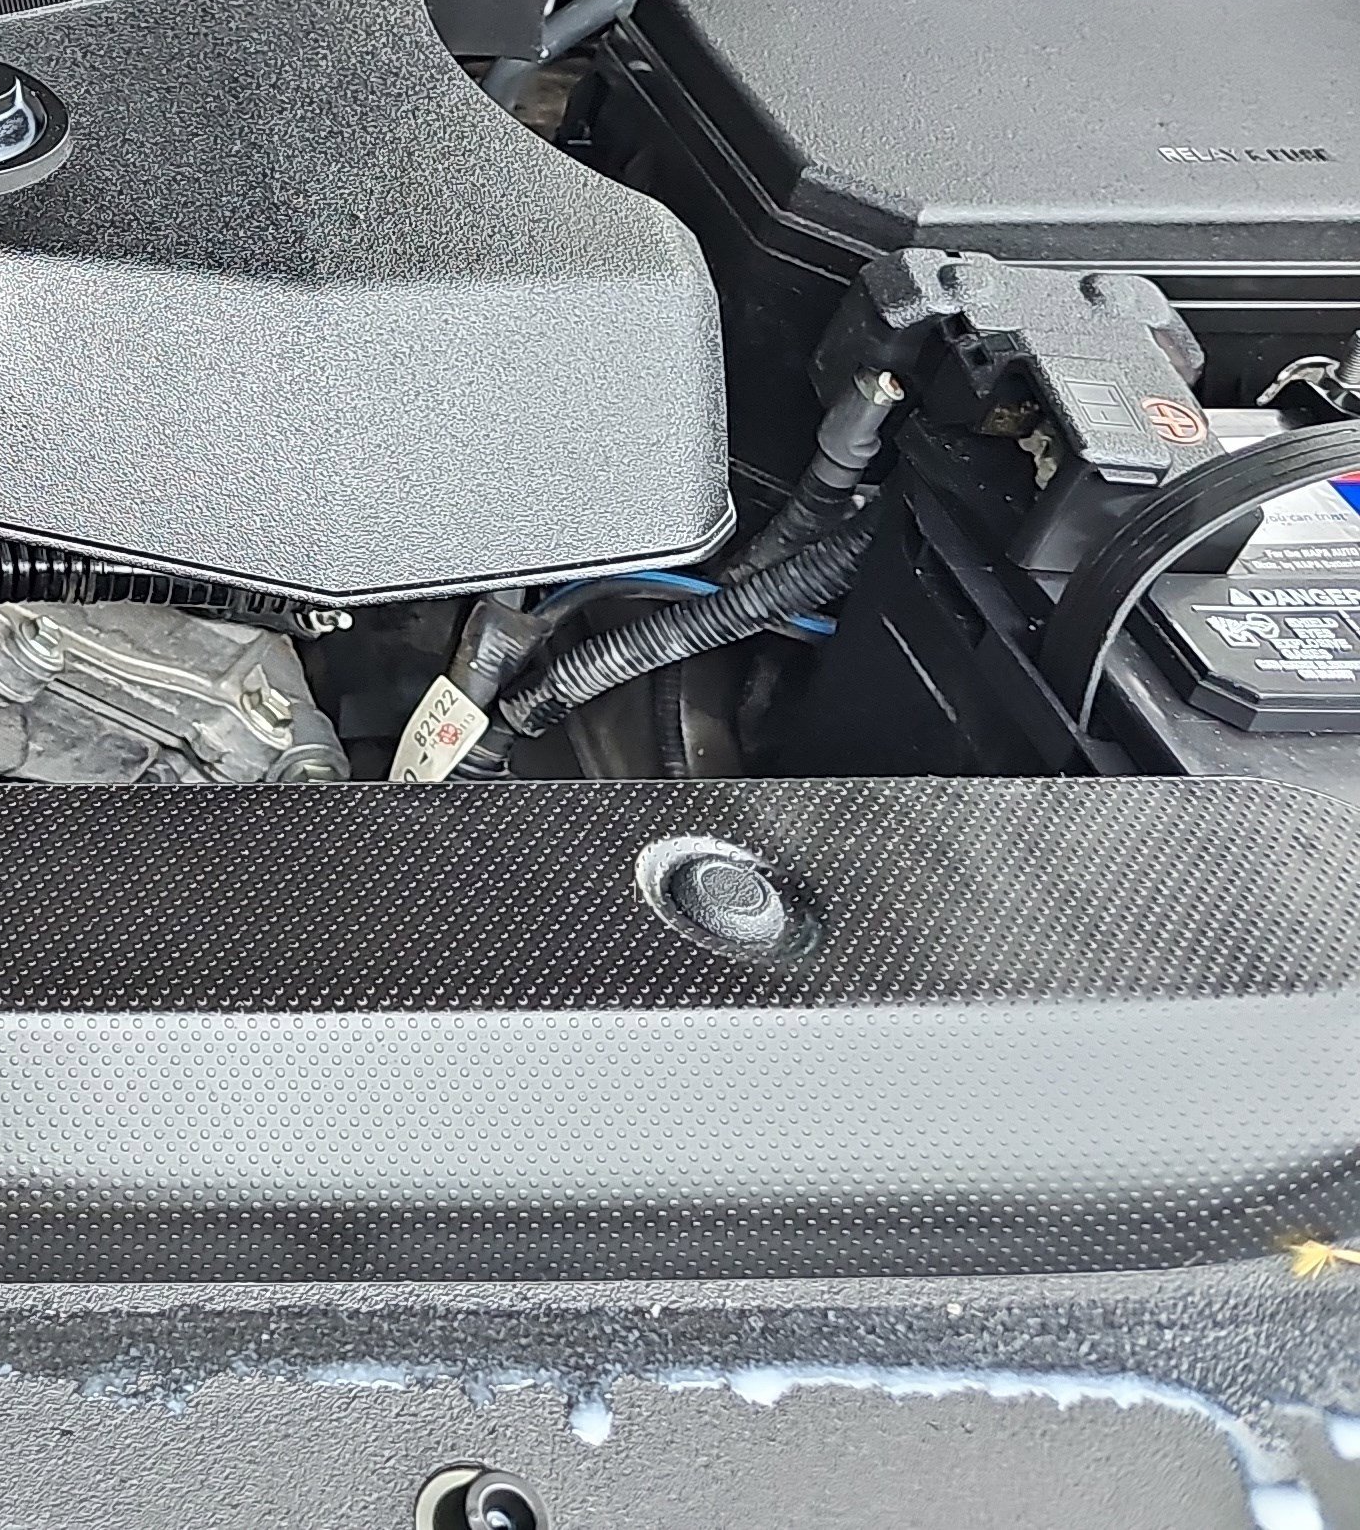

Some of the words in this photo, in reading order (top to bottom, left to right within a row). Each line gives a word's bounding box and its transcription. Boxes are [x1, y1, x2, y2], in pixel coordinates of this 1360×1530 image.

[1158, 147, 1239, 163] RELAY
[1248, 588, 1360, 606] DANGER
[414, 689, 459, 748] 82122
